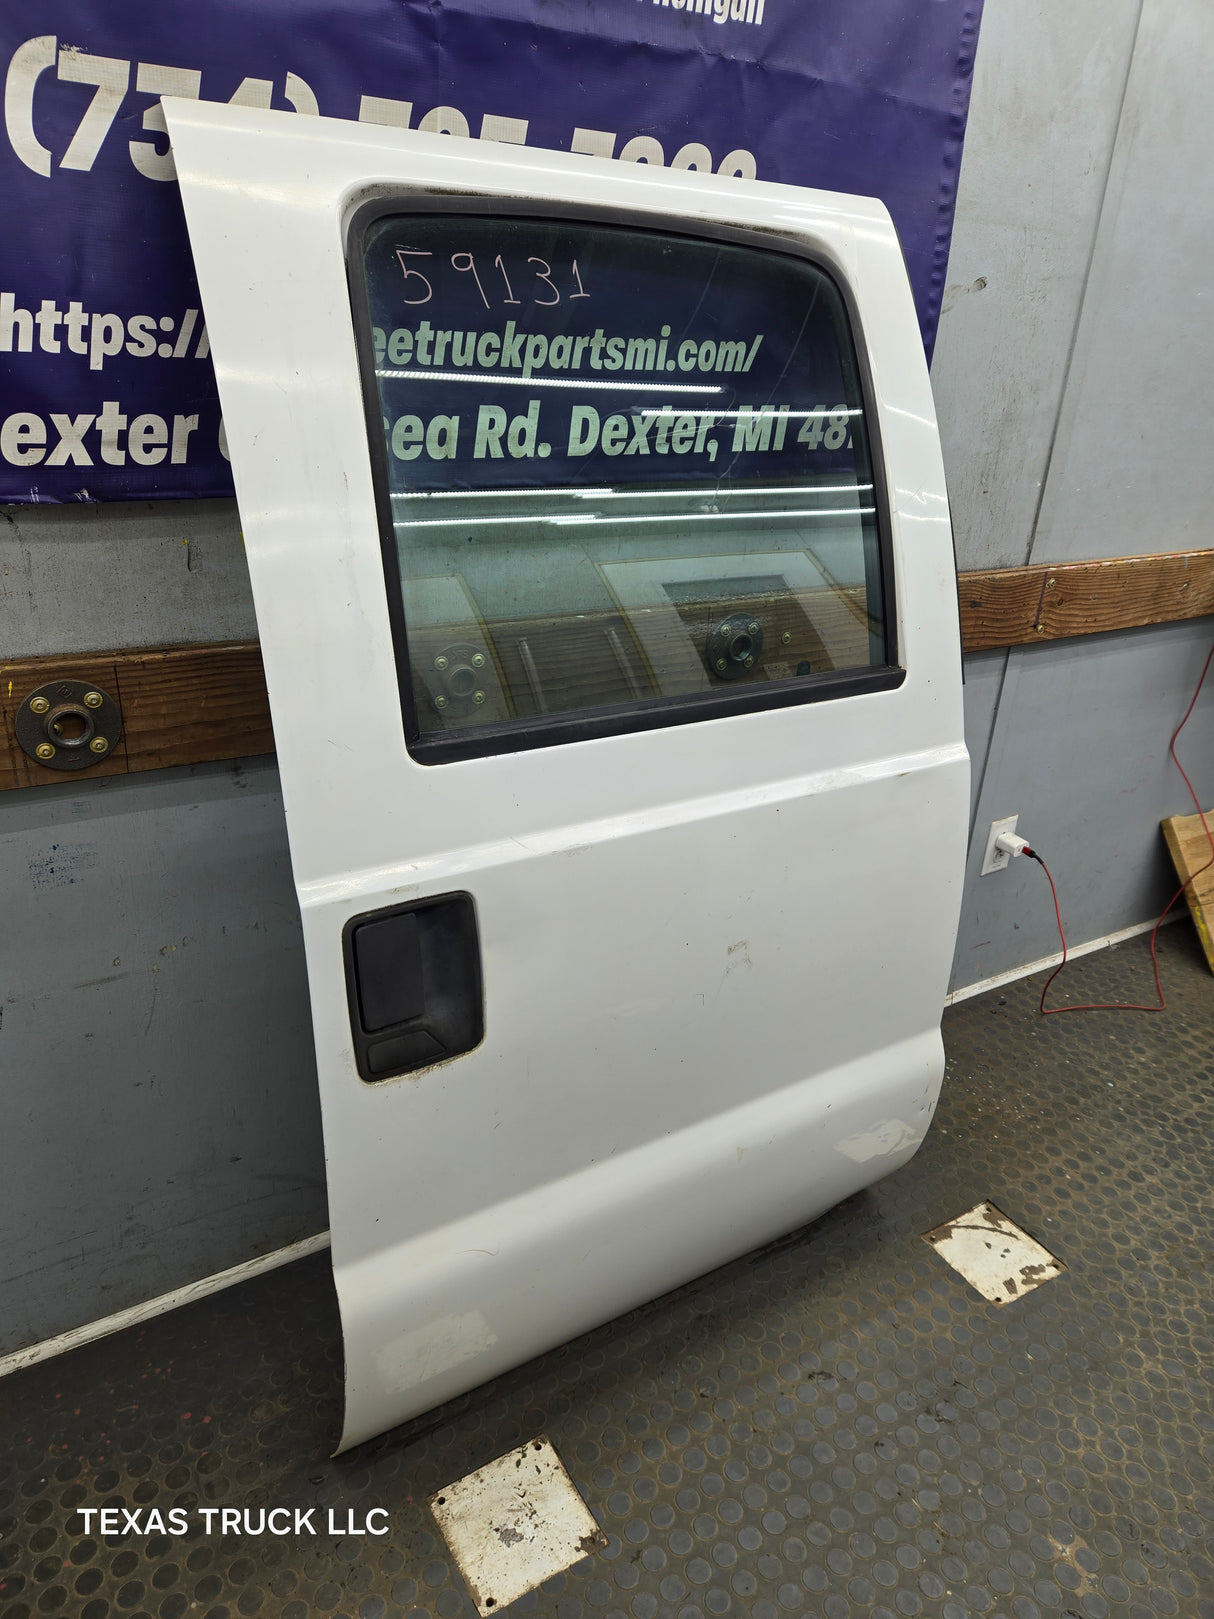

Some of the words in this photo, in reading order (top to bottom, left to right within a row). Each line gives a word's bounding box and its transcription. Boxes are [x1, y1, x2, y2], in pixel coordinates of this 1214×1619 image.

[395, 249, 591, 309] 59131
[0, 401, 199, 466] exter
[383, 414, 460, 460] ea
[473, 400, 551, 459] Rd.
[567, 405, 719, 462] Dexter,
[731, 404, 790, 452] MI
[797, 403, 853, 450] 48
